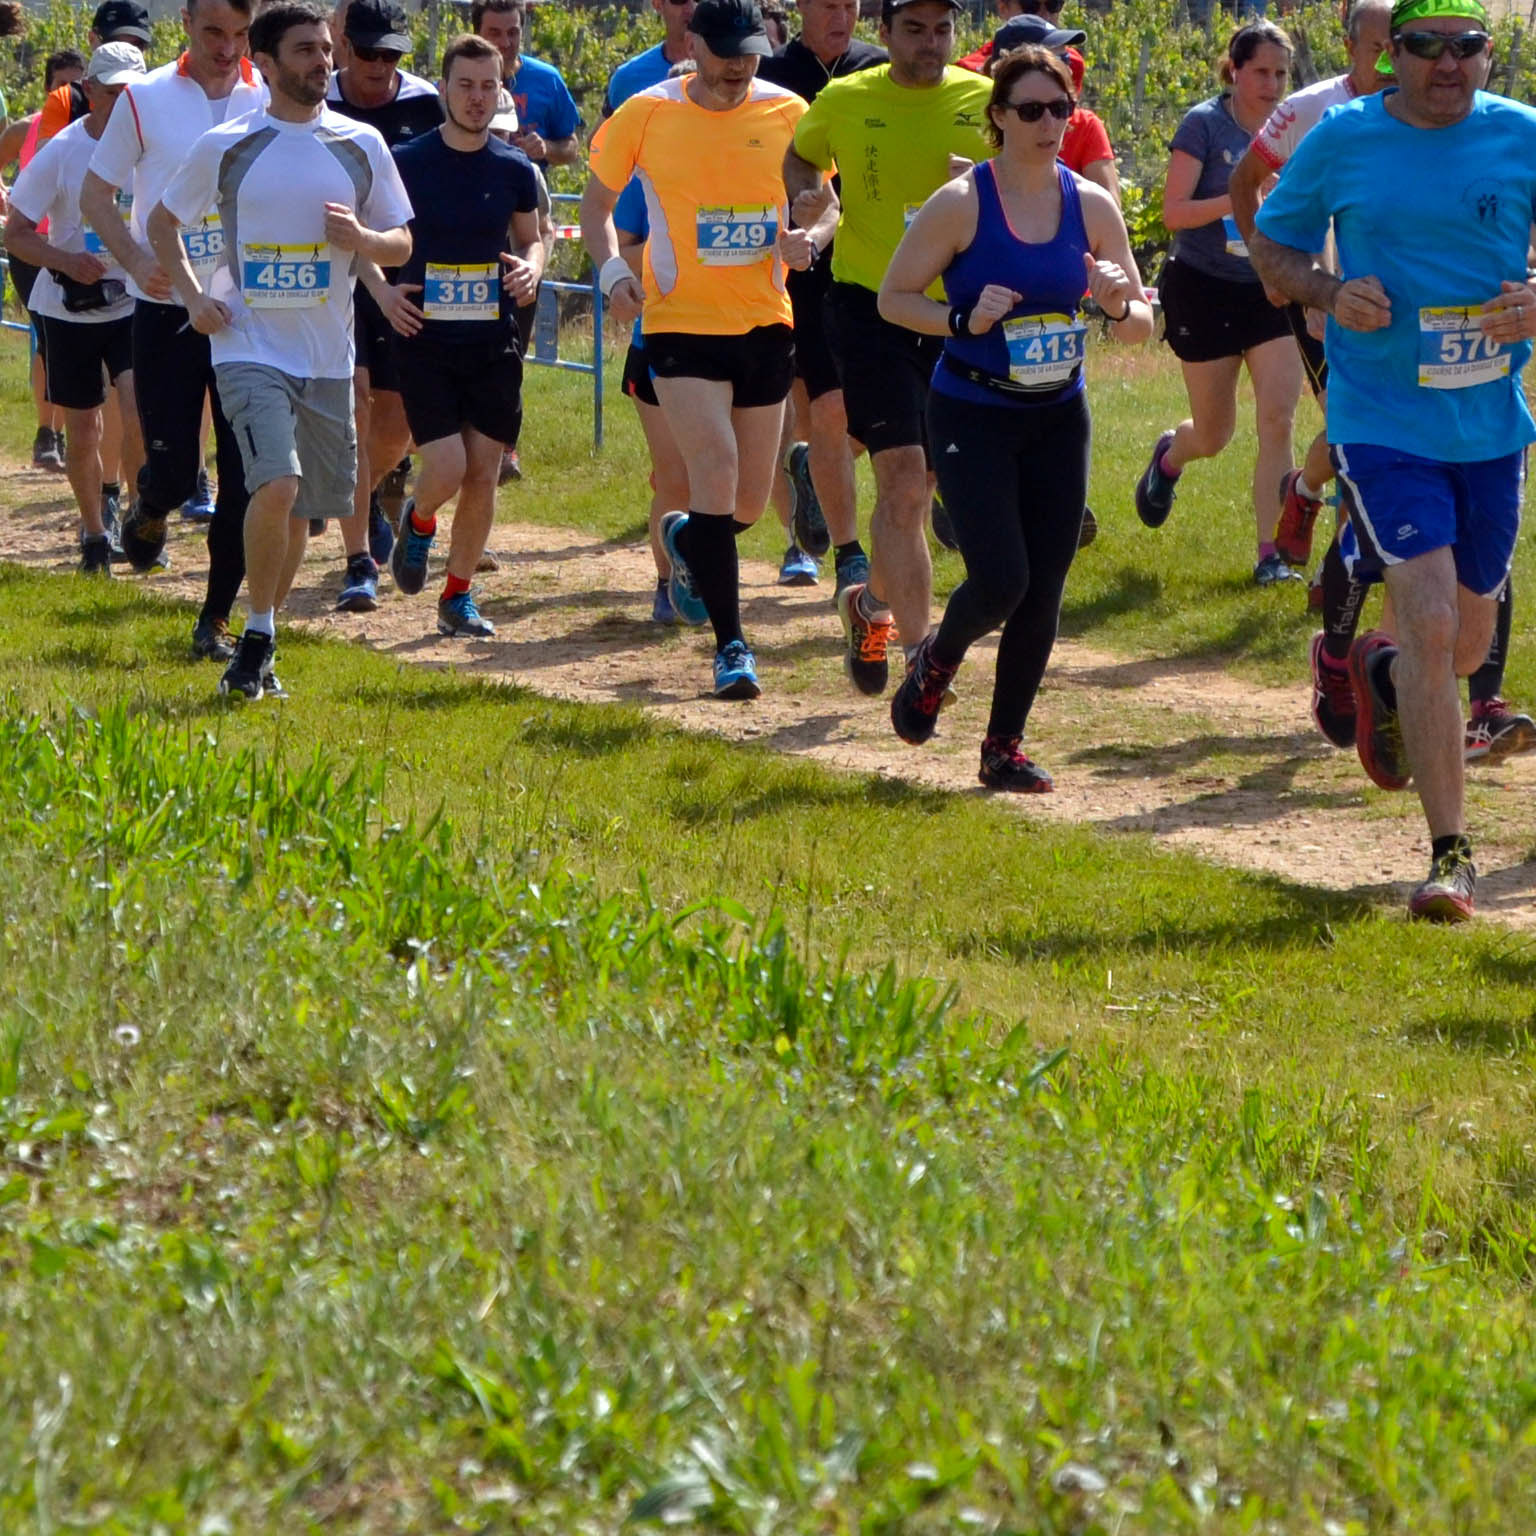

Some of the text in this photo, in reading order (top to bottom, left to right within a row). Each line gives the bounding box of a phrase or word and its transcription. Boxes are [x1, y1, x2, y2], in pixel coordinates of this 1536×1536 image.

[188, 231, 224, 257] 58
[711, 224, 766, 248] 249
[257, 264, 317, 289] 456
[438, 282, 489, 304] 319
[1025, 333, 1076, 363] 413
[1440, 331, 1501, 363] 570
